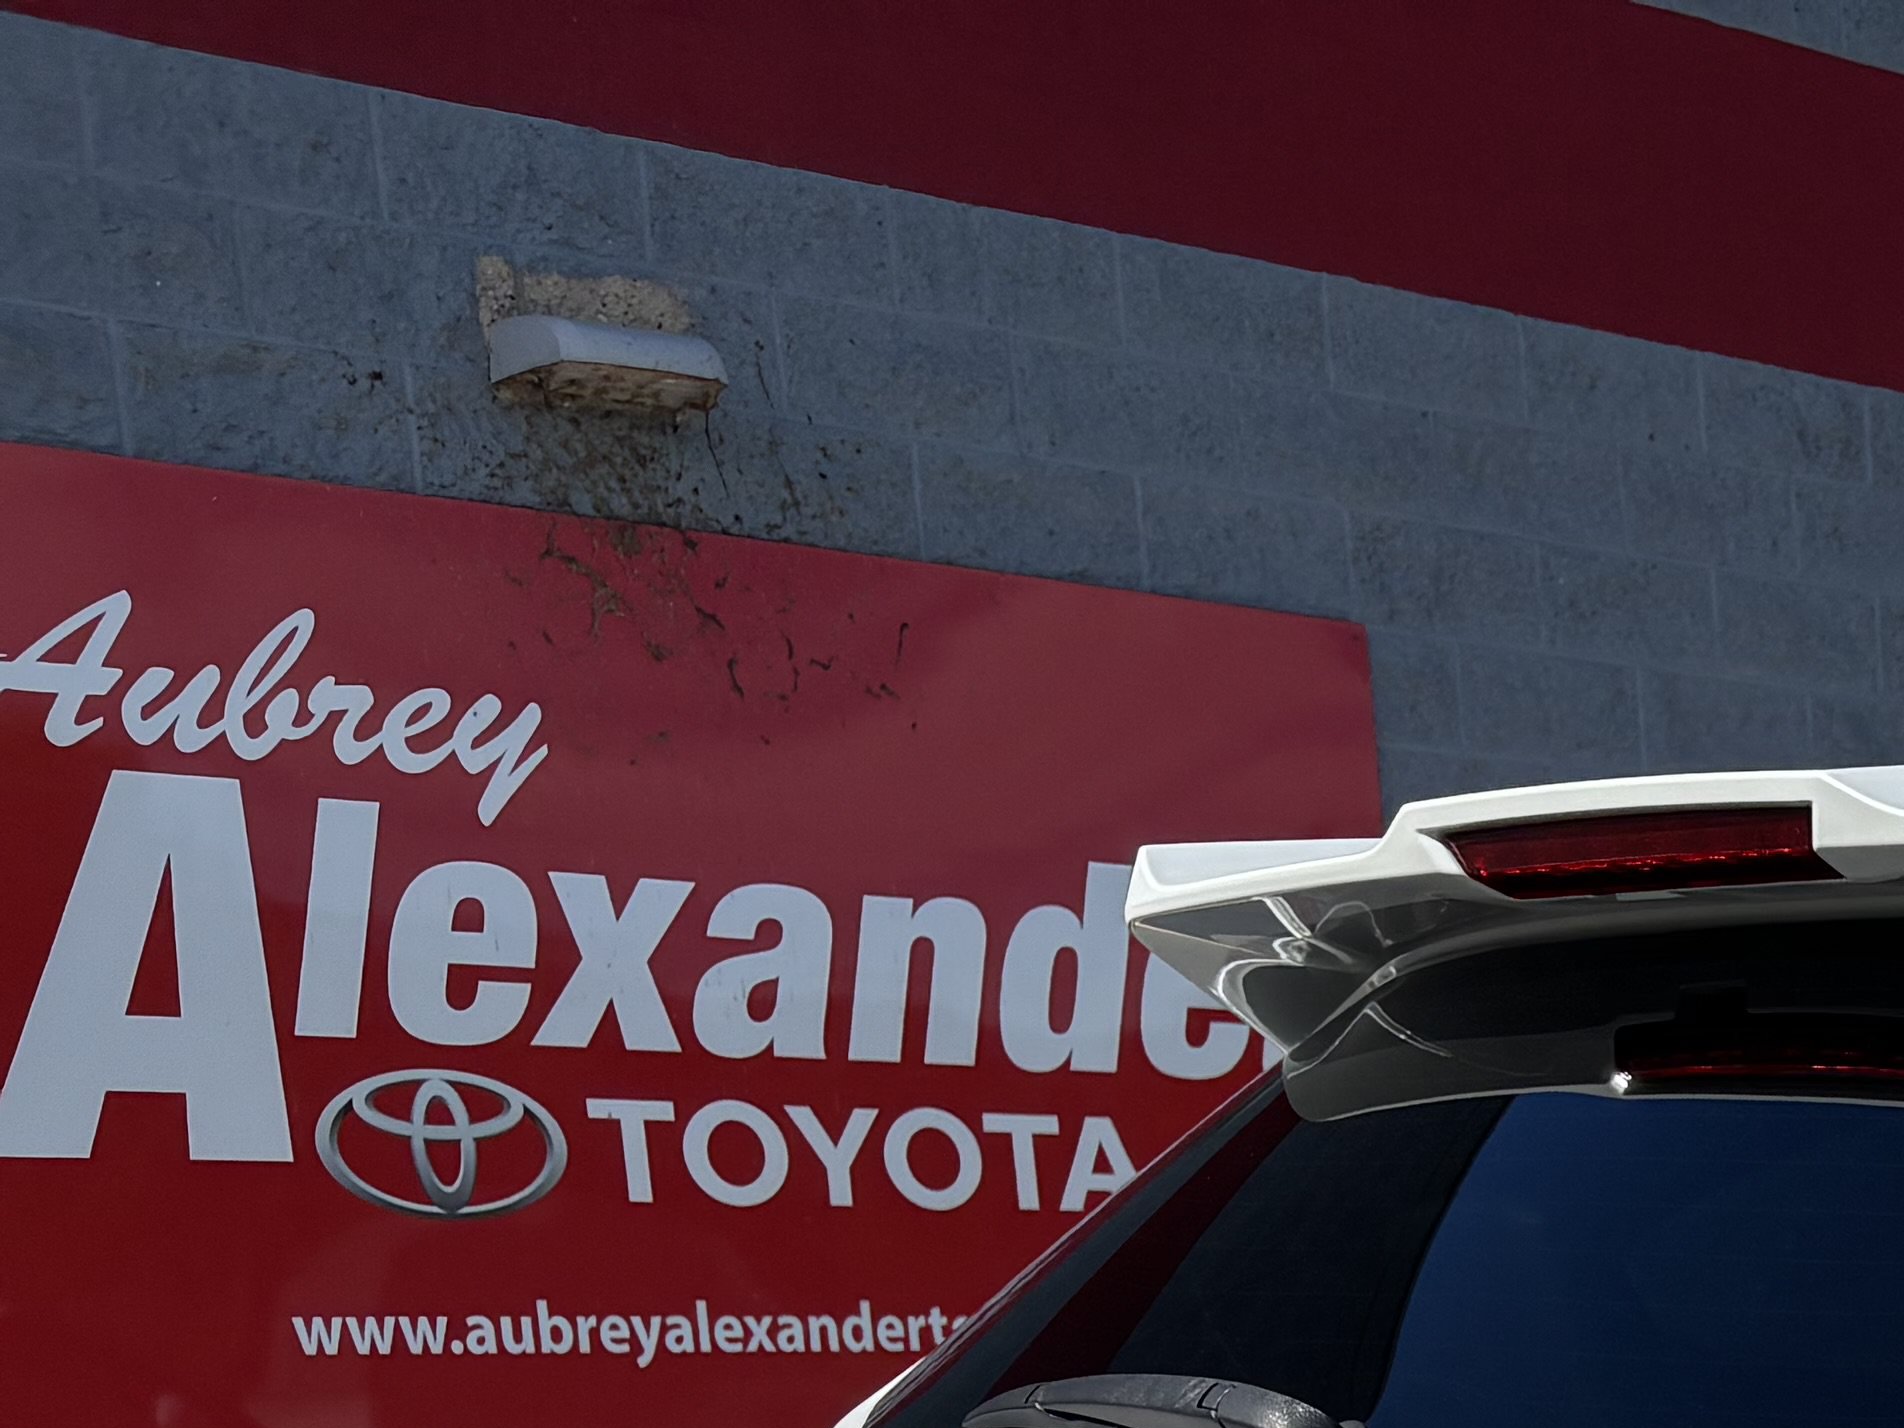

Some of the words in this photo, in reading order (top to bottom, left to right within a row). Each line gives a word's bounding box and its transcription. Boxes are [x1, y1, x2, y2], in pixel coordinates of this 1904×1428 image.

[0, 590, 548, 825] Aubrey
[0, 769, 1284, 1164] Alexande
[586, 1098, 1137, 1212] TOYOTA
[290, 1299, 972, 1368] www.aubreyalexandert
